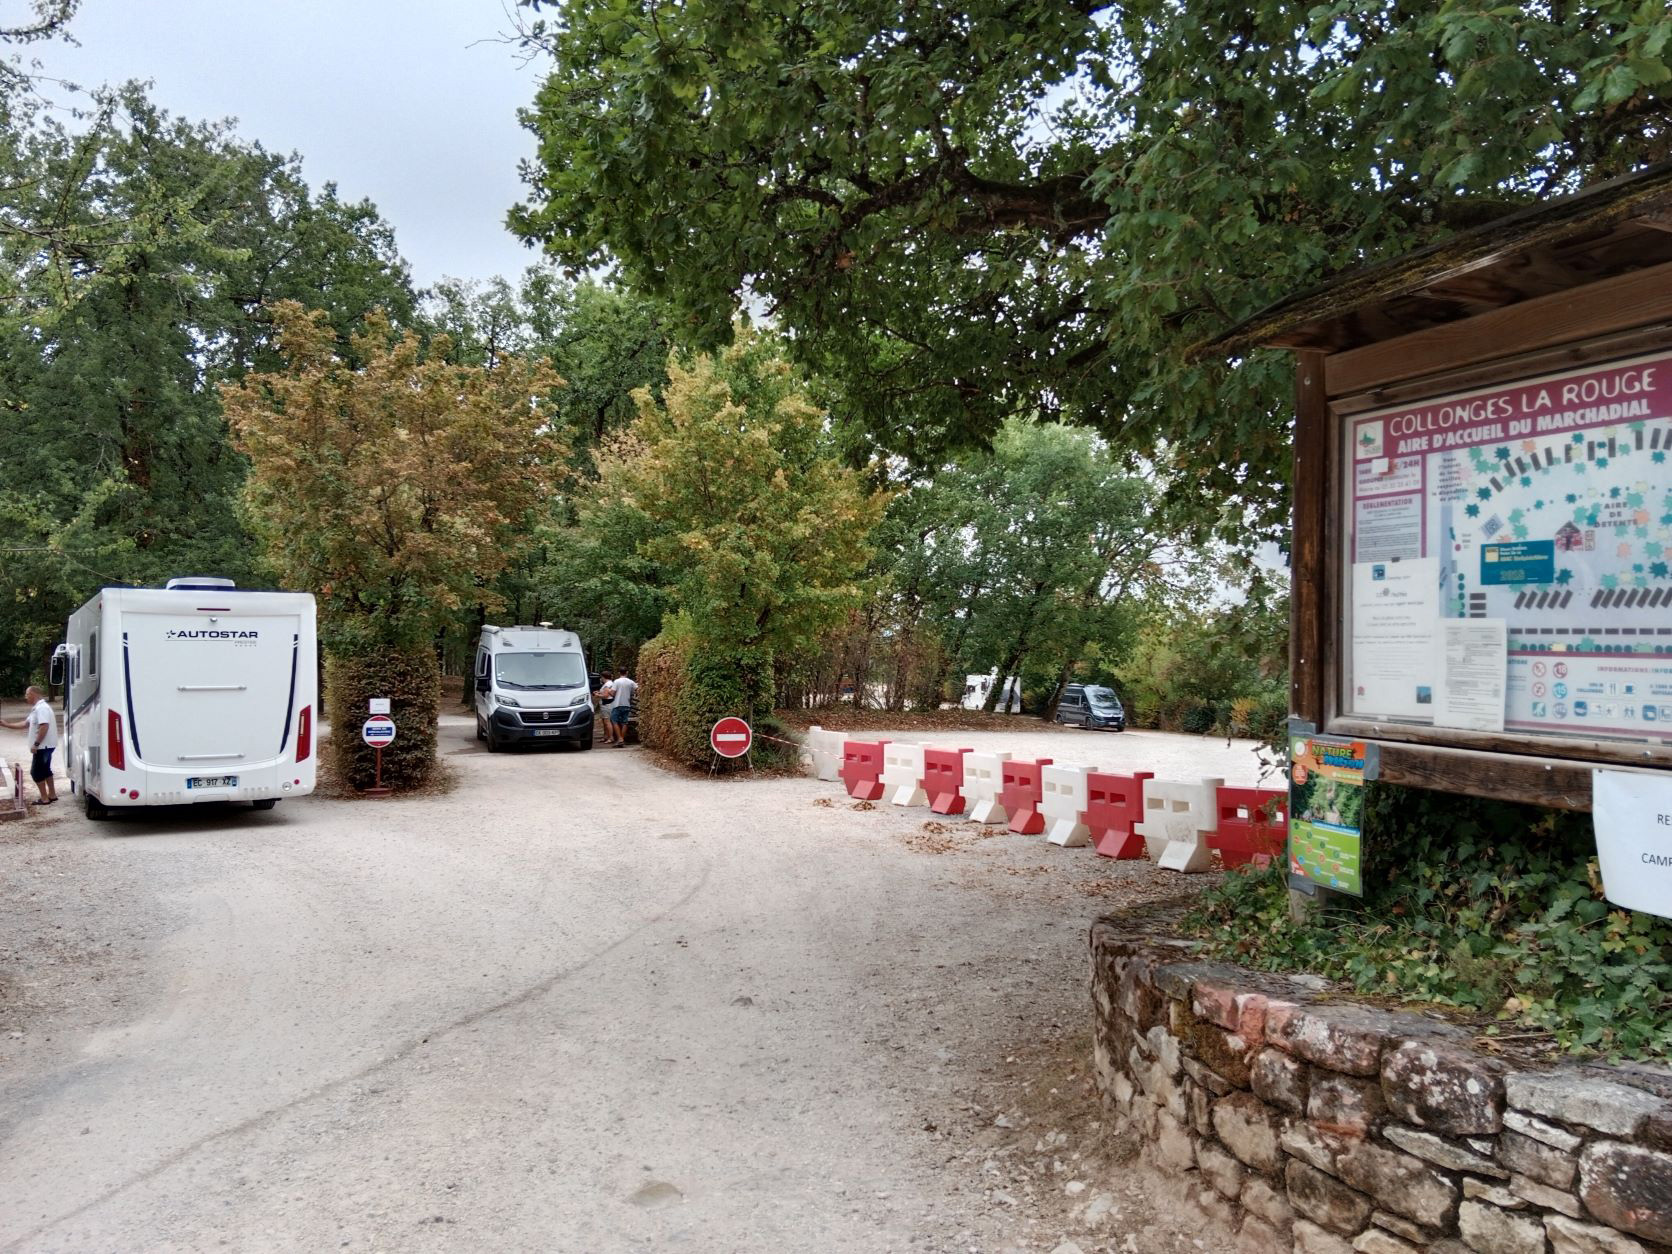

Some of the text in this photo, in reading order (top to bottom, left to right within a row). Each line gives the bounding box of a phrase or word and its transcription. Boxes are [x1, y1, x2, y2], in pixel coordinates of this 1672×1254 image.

[1390, 368, 1657, 437] COLLONGES LA ROUGE
[1397, 398, 1652, 454] AIRE D'ACCUEIL DU MARCHADIAL
[177, 630, 258, 639] AUTOSTAR
[1312, 744, 1353, 759] NATURE
